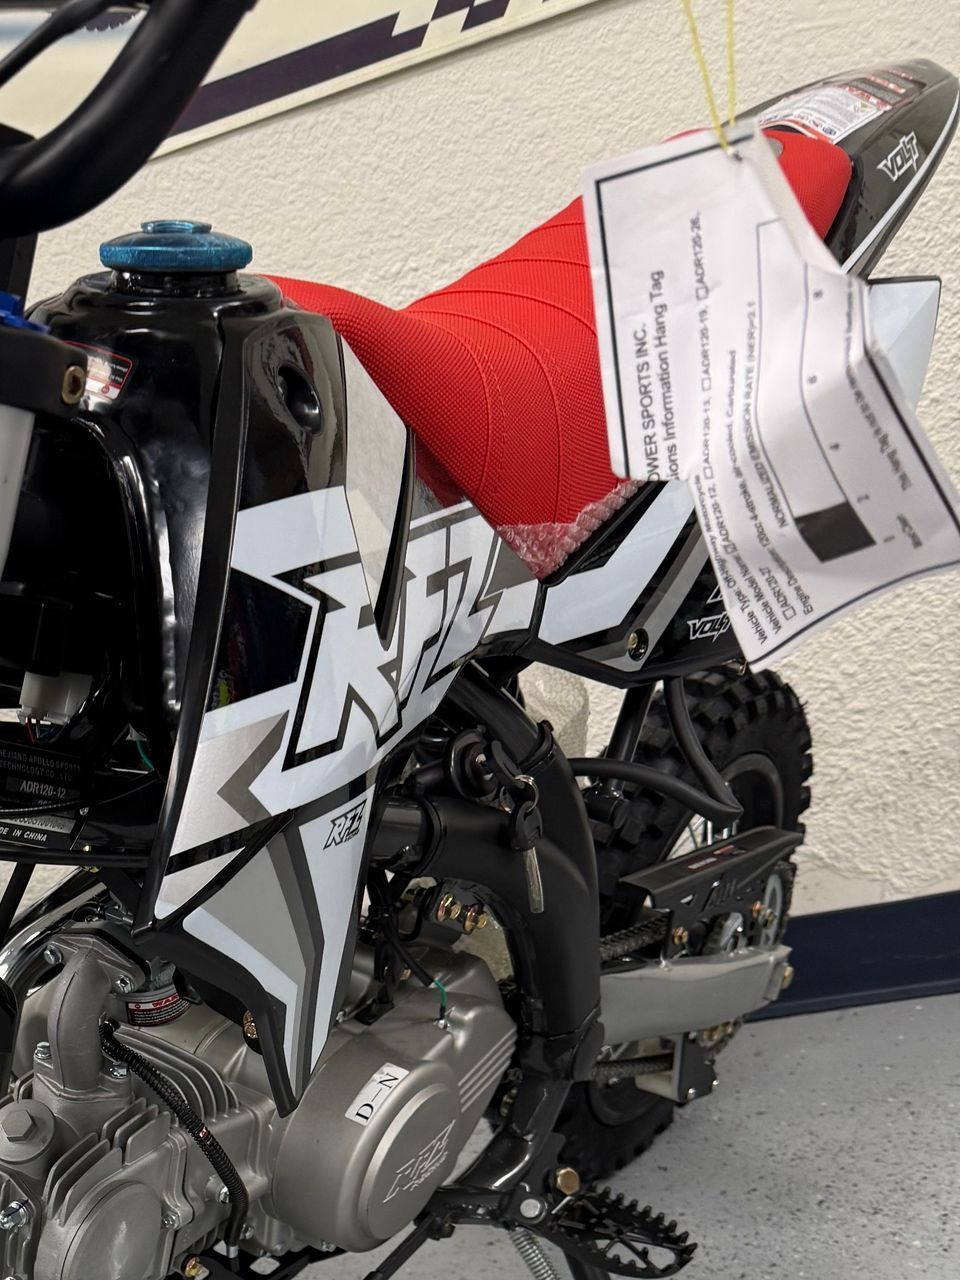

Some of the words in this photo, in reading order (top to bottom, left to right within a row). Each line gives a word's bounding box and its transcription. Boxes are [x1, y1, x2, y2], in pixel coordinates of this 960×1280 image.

[877, 131, 920, 182] VOLT
[649, 270, 665, 303] Tag
[633, 323, 648, 358] INC.
[653, 303, 668, 348] Hang
[637, 361, 656, 431] SPORTS
[658, 351, 676, 442] Information
[794, 585, 813, 615] Engine
[747, 611, 768, 645] Vehicle
[760, 601, 783, 635] Vehicle
[28, 754, 55, 768] APOLLO
[19, 780, 66, 799] ADR120-12
[23, 832, 47, 842] CHINA
